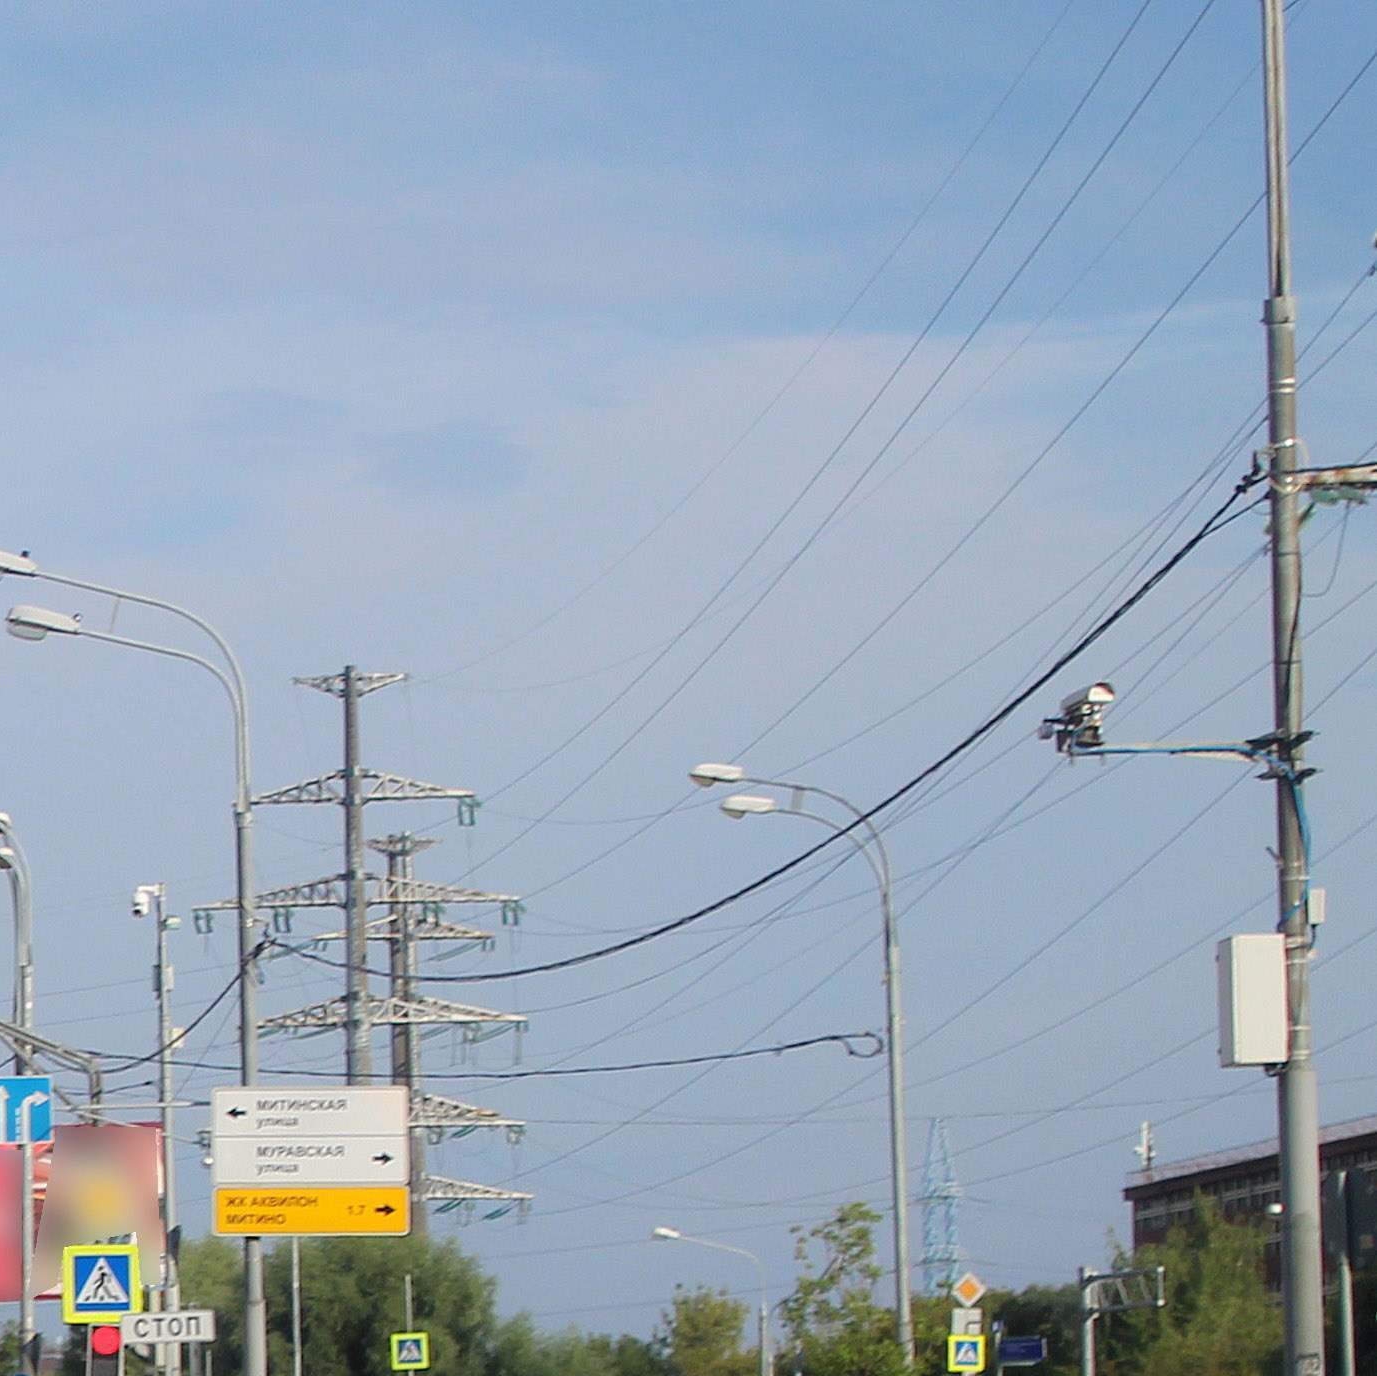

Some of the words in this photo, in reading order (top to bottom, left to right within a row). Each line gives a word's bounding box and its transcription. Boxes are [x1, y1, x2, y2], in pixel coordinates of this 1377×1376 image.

[255, 1099, 348, 1111] МИТИНСКАЯ
[255, 1117, 299, 1129] улица
[255, 1146, 346, 1158] МУРАВСКАЯ
[255, 1163, 299, 1175] улица
[250, 1196, 319, 1207] АКВИЛОН
[226, 1213, 287, 1225] МИТИНО
[134, 1316, 201, 1338] СТОП
